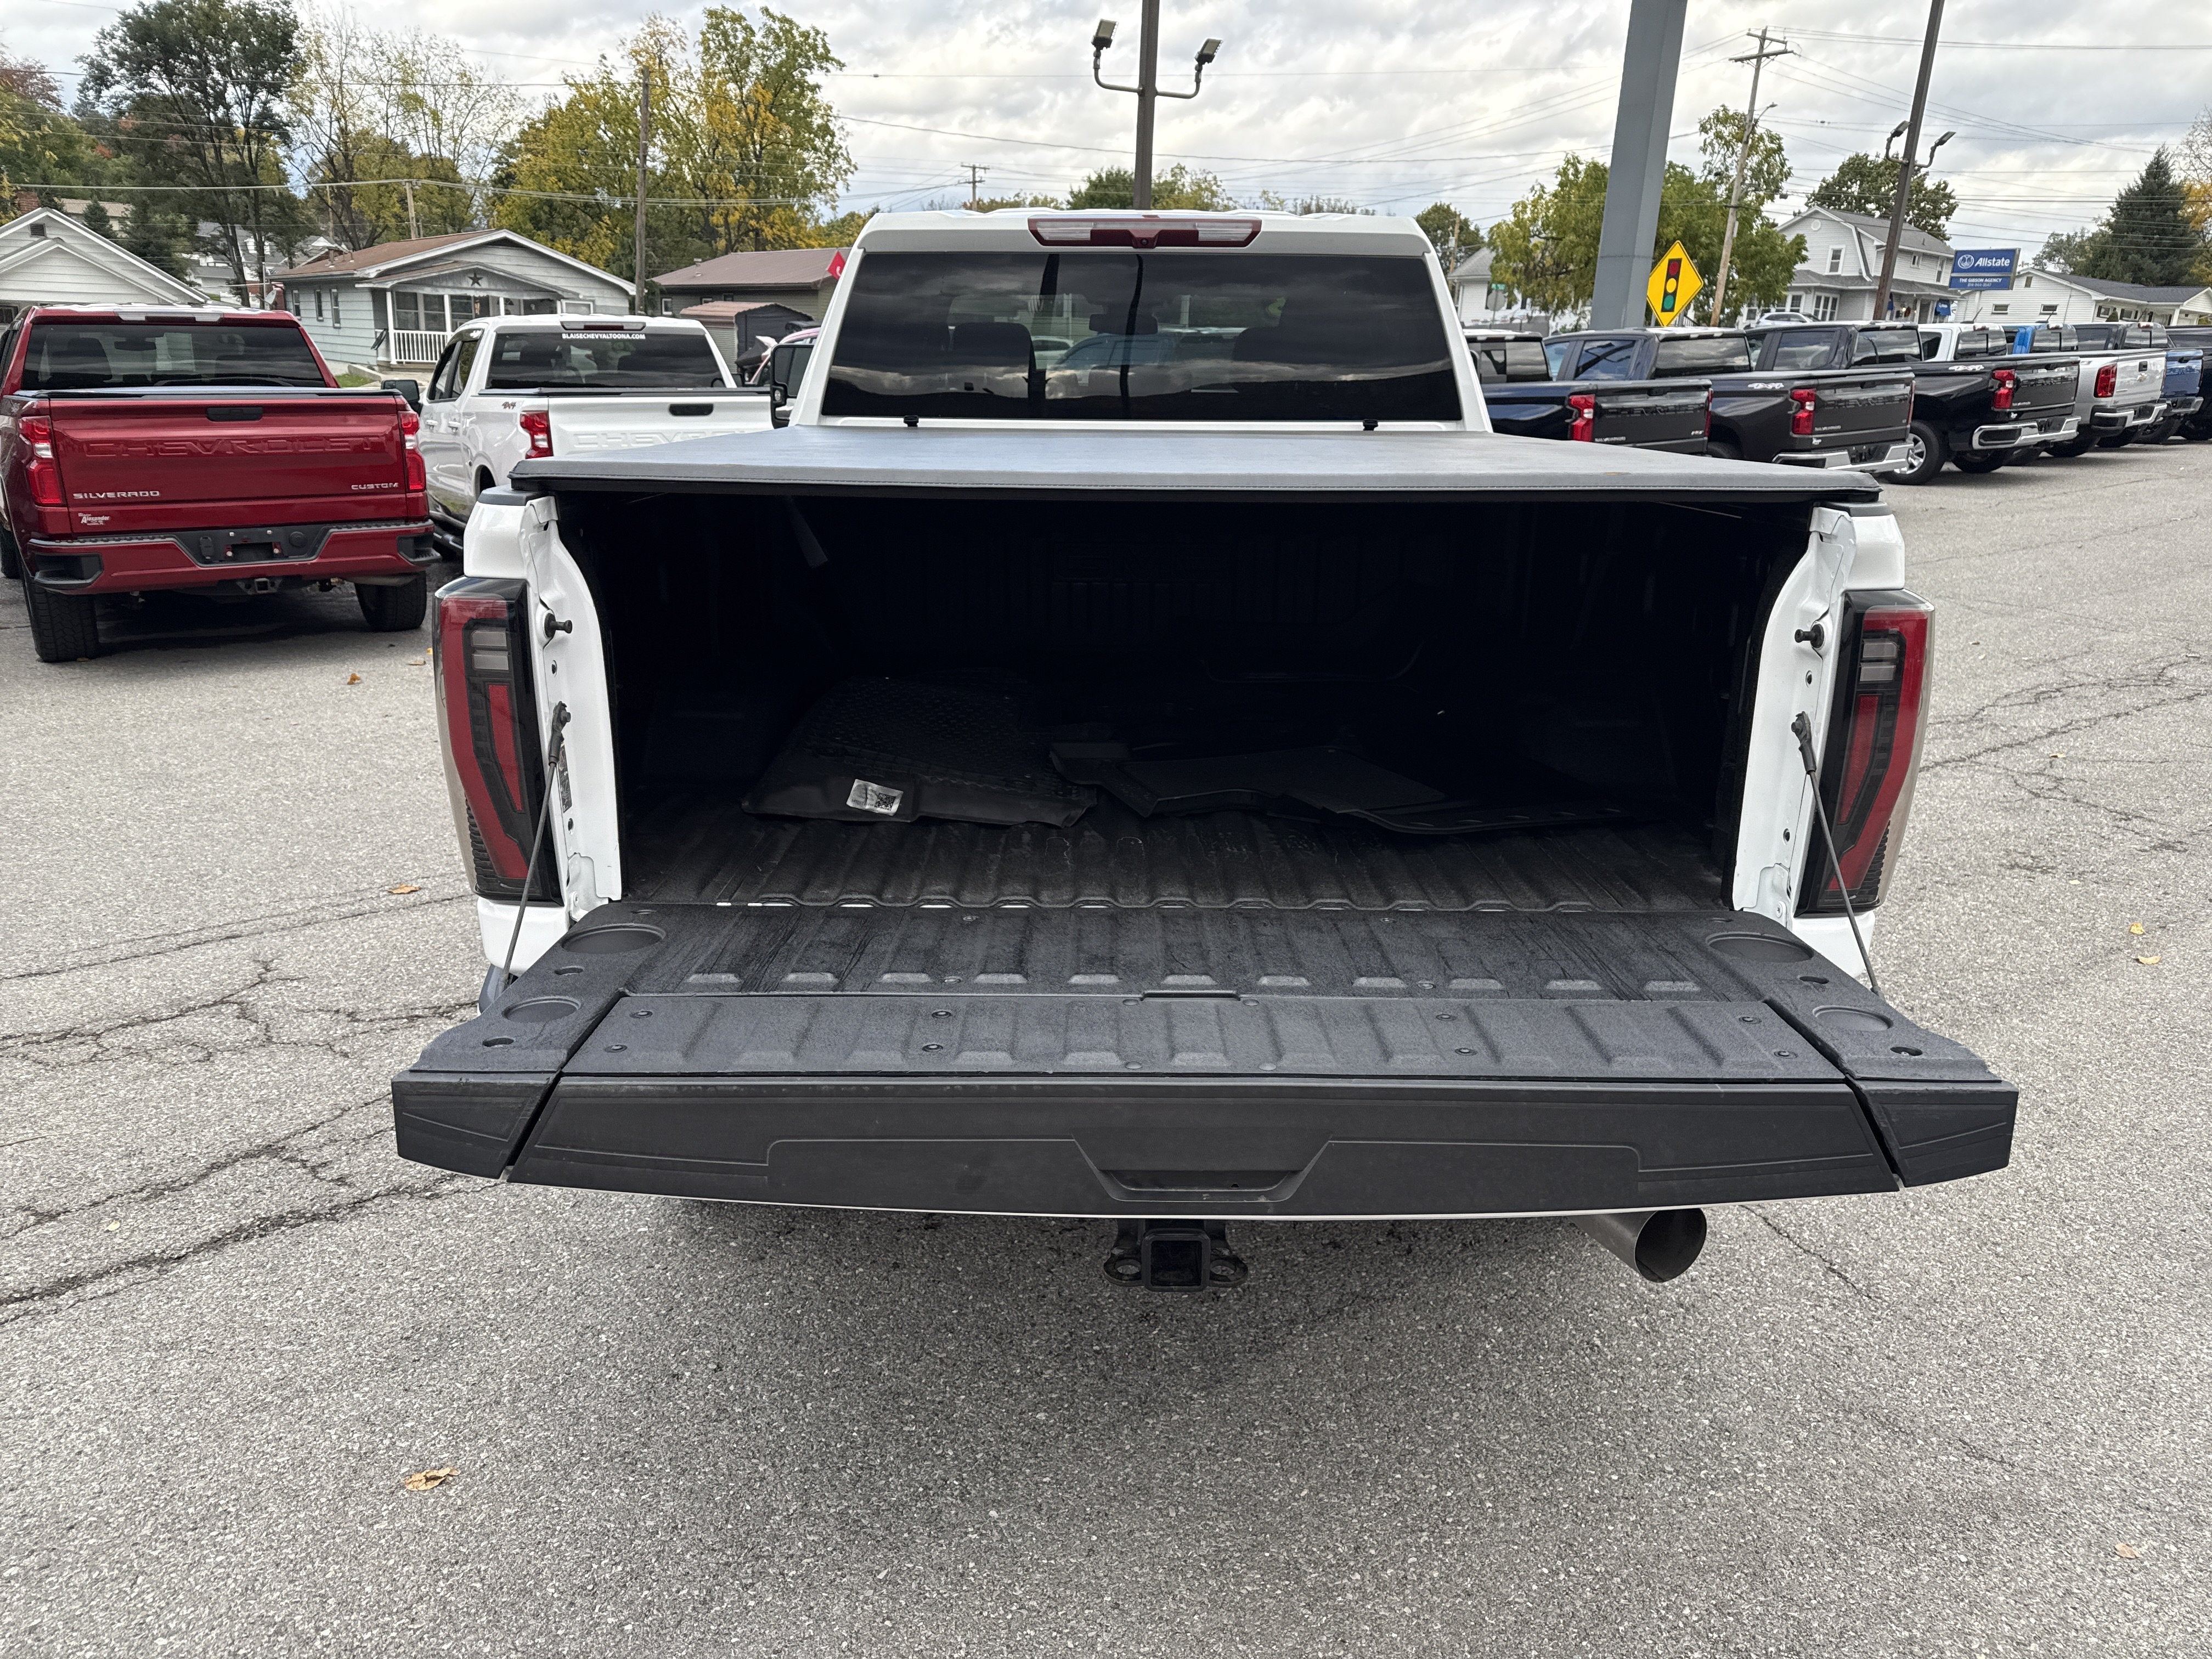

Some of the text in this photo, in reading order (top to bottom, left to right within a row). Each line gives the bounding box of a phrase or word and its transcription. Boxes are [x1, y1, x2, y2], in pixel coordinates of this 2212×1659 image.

[1974, 257, 2011, 267] Allstate
[84, 437, 382, 457] CHEVROLET
[72, 490, 160, 499] SILVERADO
[80, 515, 110, 524] Alexander
